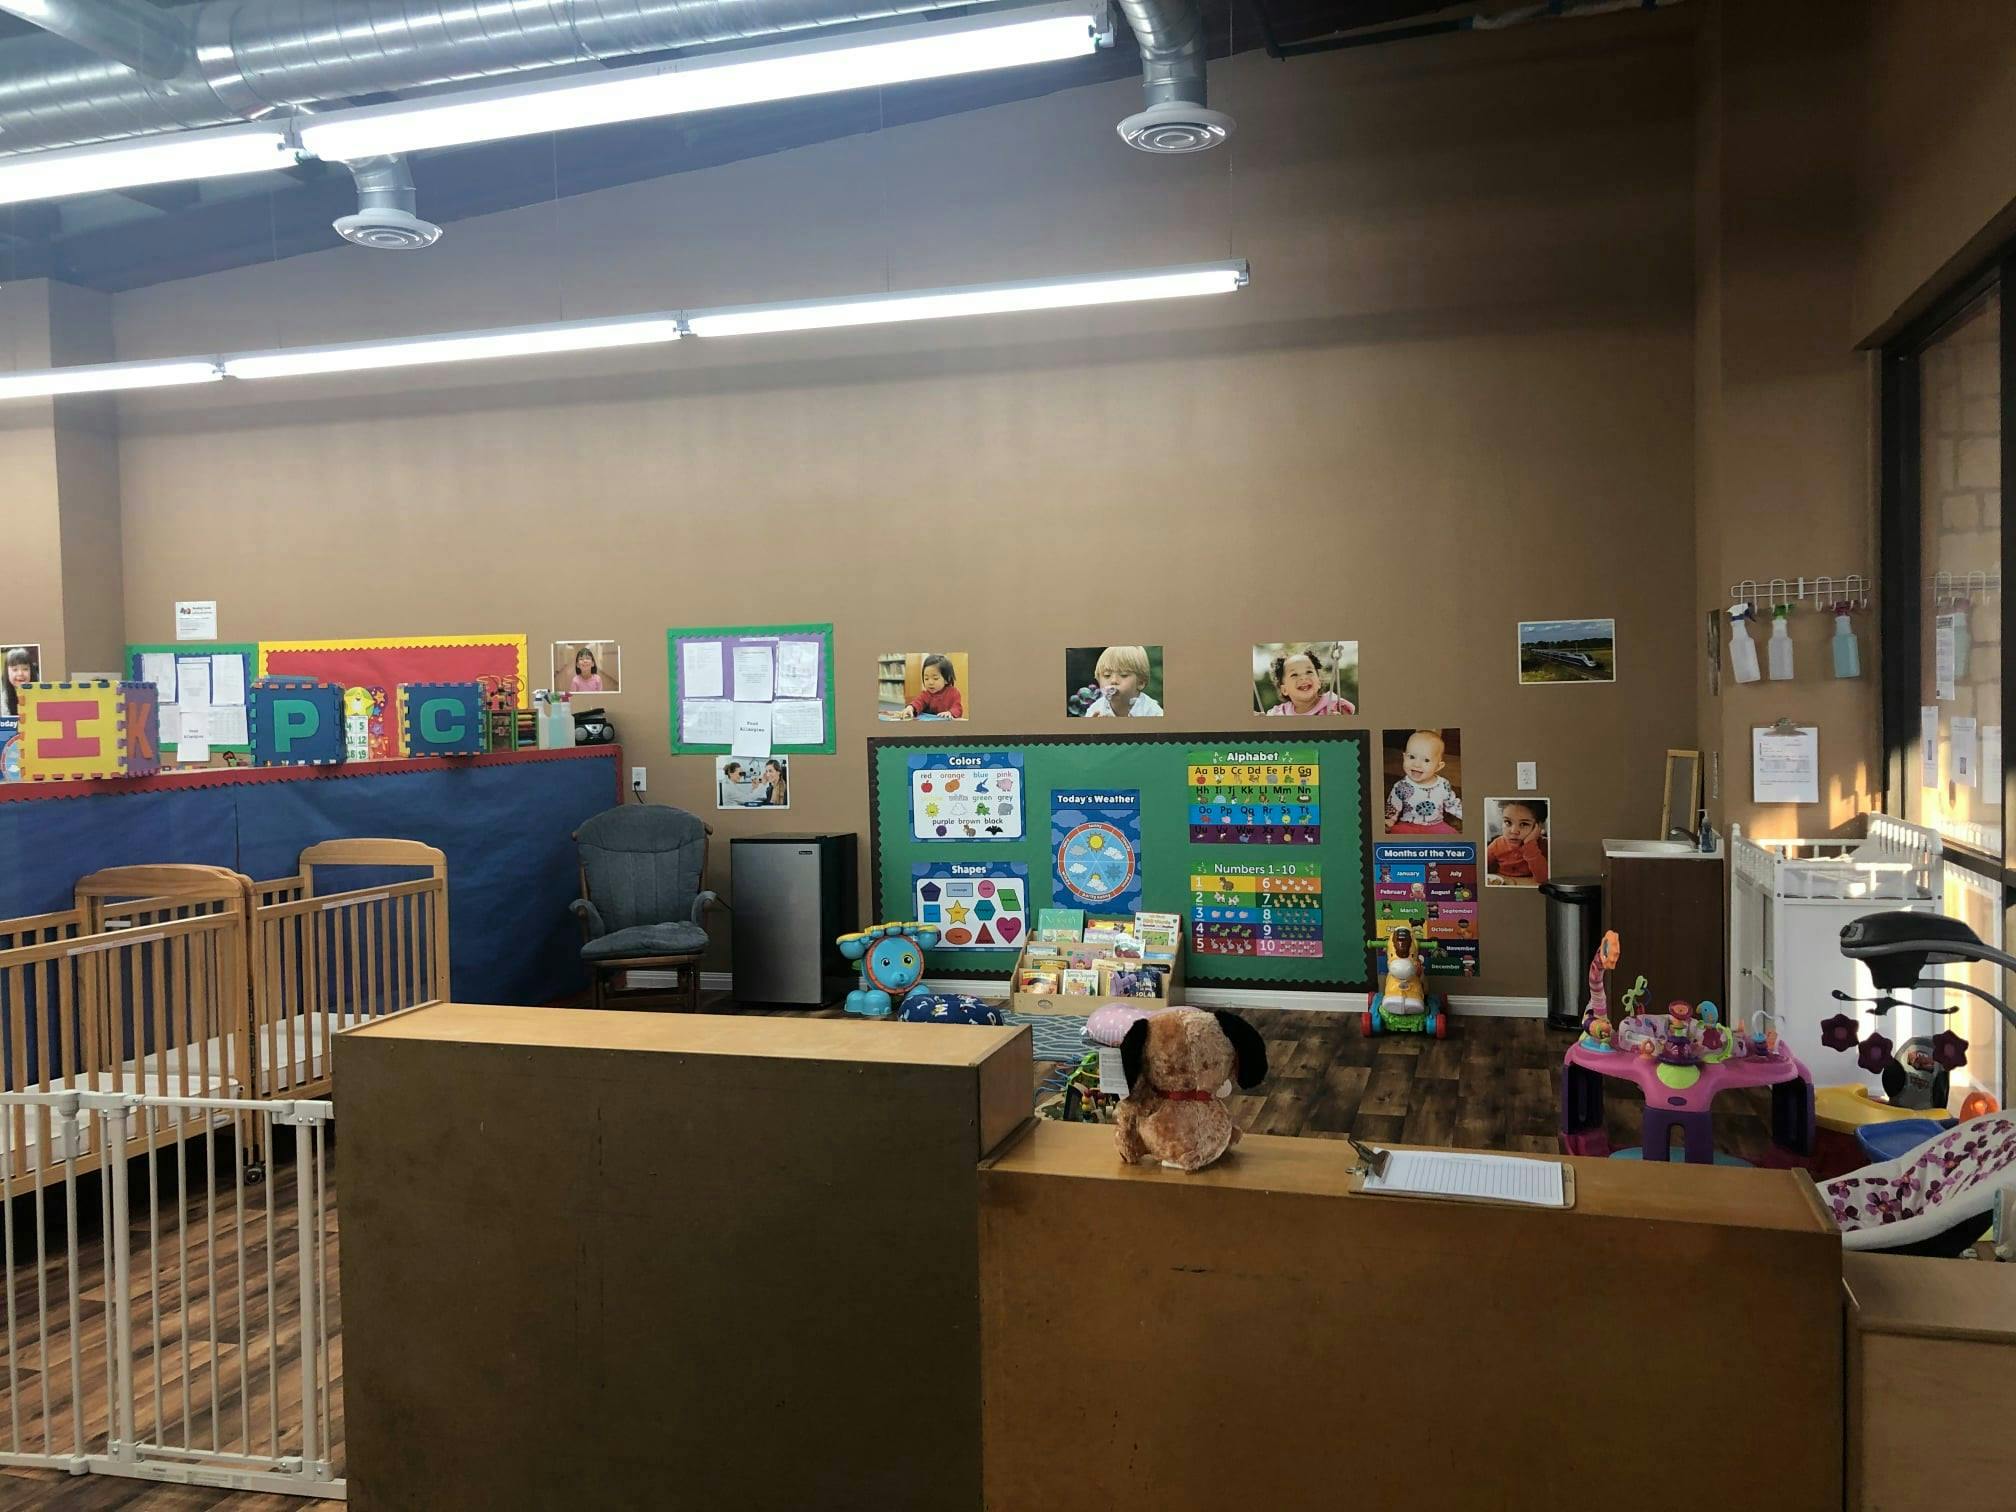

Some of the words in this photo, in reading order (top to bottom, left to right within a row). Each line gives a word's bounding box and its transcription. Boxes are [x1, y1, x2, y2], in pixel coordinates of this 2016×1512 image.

[0, 719, 18, 729] oday
[273, 699, 320, 753] P
[359, 721, 365, 730] 5
[420, 698, 467, 744] C
[127, 702, 154, 760] K
[358, 736, 367, 745] 12
[949, 756, 982, 766] Colors
[1226, 751, 1279, 763] Alphabet
[996, 770, 1013, 779] pink
[1195, 766, 1208, 775] Aa
[1213, 766, 1226, 775] Bb
[1231, 766, 1242, 775] Cc
[1247, 766, 1261, 775] Dd
[1266, 766, 1278, 775] Ee
[1283, 766, 1293, 775] Ff
[1297, 766, 1312, 776] Gg
[1196, 786, 1210, 794] Hh
[1215, 786, 1222, 794] Ii
[1228, 786, 1235, 796] Jj
[1241, 786, 1254, 794] Kk
[1259, 786, 1267, 794] Ll
[1273, 786, 1292, 794] Mm
[1297, 786, 1311, 794] Nn
[972, 794, 993, 802] green
[997, 794, 1014, 803] grey
[1057, 795, 1093, 805] Today's
[1093, 795, 1135, 804] Weather
[1198, 806, 1212, 814] Oo
[1220, 806, 1232, 816] Pp
[1240, 806, 1255, 816] Qq
[1262, 806, 1273, 814] Rr
[1280, 806, 1291, 814] Ss
[1299, 806, 1310, 814] Tt
[932, 817, 955, 826] purple
[984, 817, 1004, 825] black
[1384, 849, 1417, 858] Months
[1418, 849, 1429, 857] of
[1429, 849, 1444, 857] the
[1445, 849, 1466, 857] Year
[951, 865, 987, 875] Shapes
[1214, 863, 1265, 874] Numbers
[1396, 870, 1420, 878] January
[1449, 870, 1462, 878] July
[1195, 876, 1203, 887] 1
[1262, 877, 1271, 889] 6
[1195, 891, 1203, 903] 2
[1379, 889, 1407, 897] February
[1262, 893, 1271, 904] 7
[1195, 907, 1204, 918] 3
[1262, 908, 1272, 920] 8
[1195, 922, 1205, 934] 4
[1263, 924, 1272, 936] 9
[1196, 937, 1205, 949] 5
[1260, 939, 1275, 951] 10
